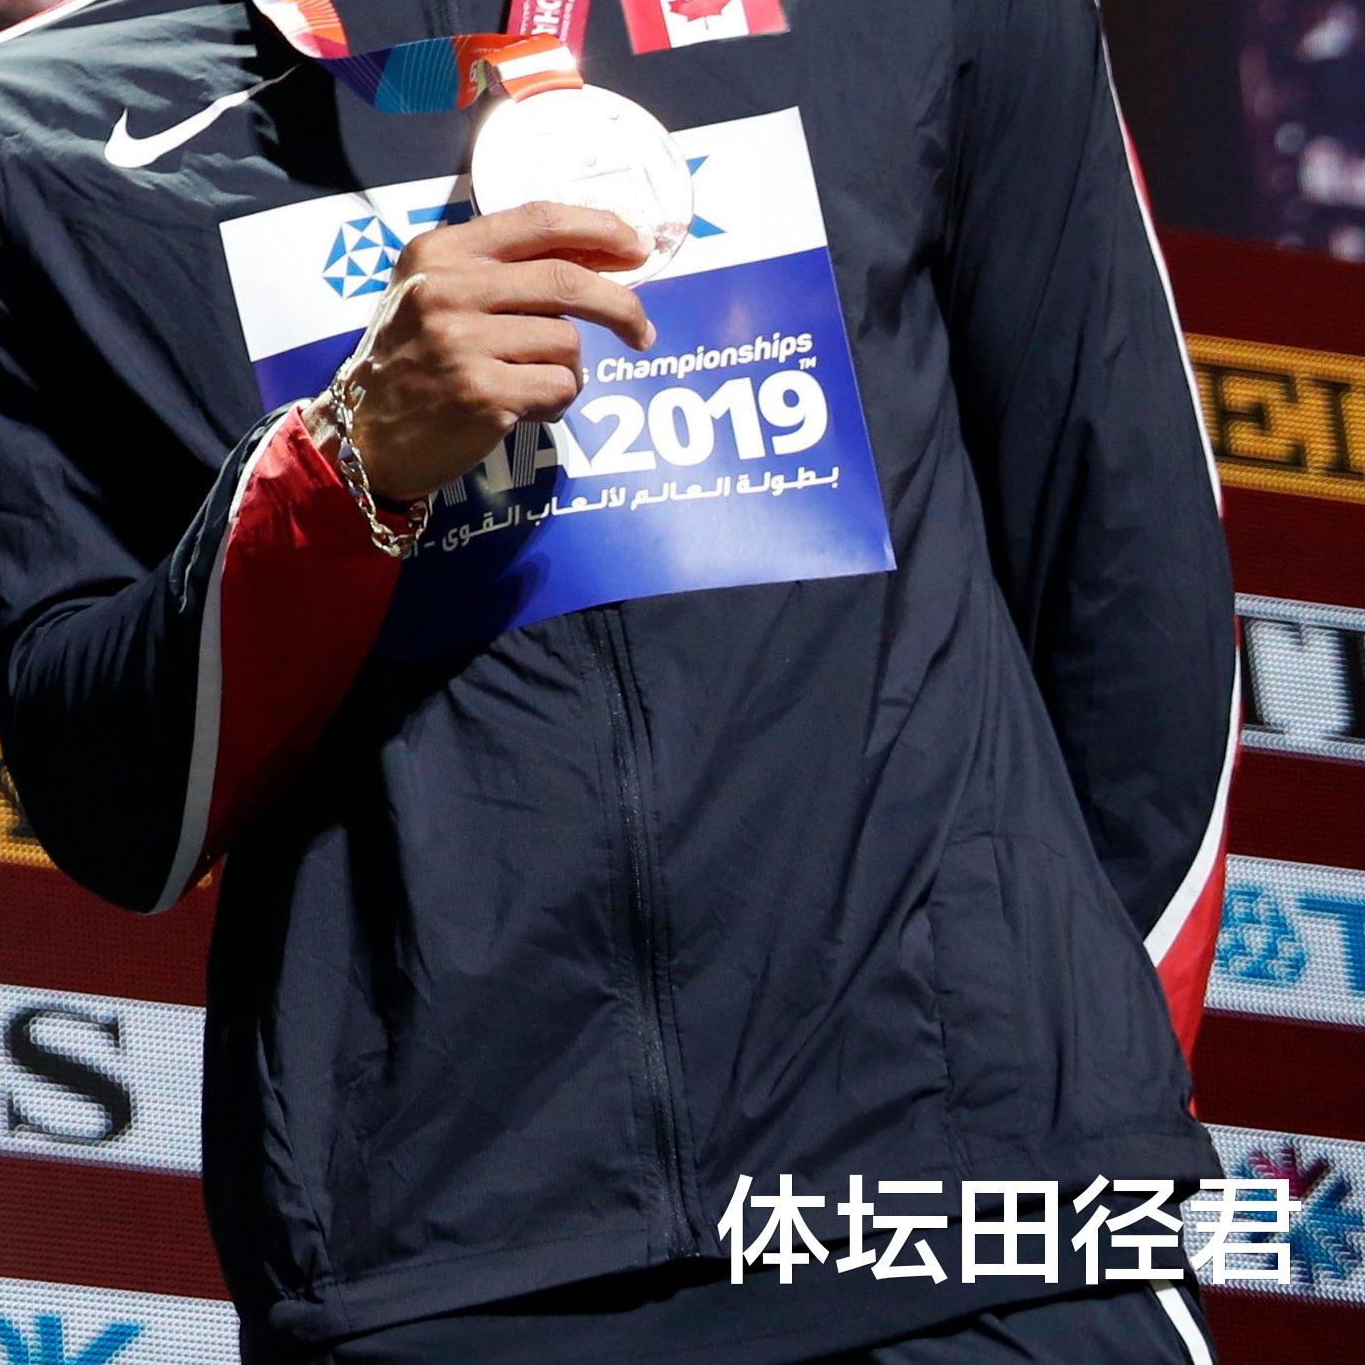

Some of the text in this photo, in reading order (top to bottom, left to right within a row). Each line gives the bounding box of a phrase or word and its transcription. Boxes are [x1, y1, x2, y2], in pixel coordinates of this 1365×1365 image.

[596, 332, 813, 383] Championships
[630, 475, 731, 510] العالم
[736, 466, 840, 497] بطولة
